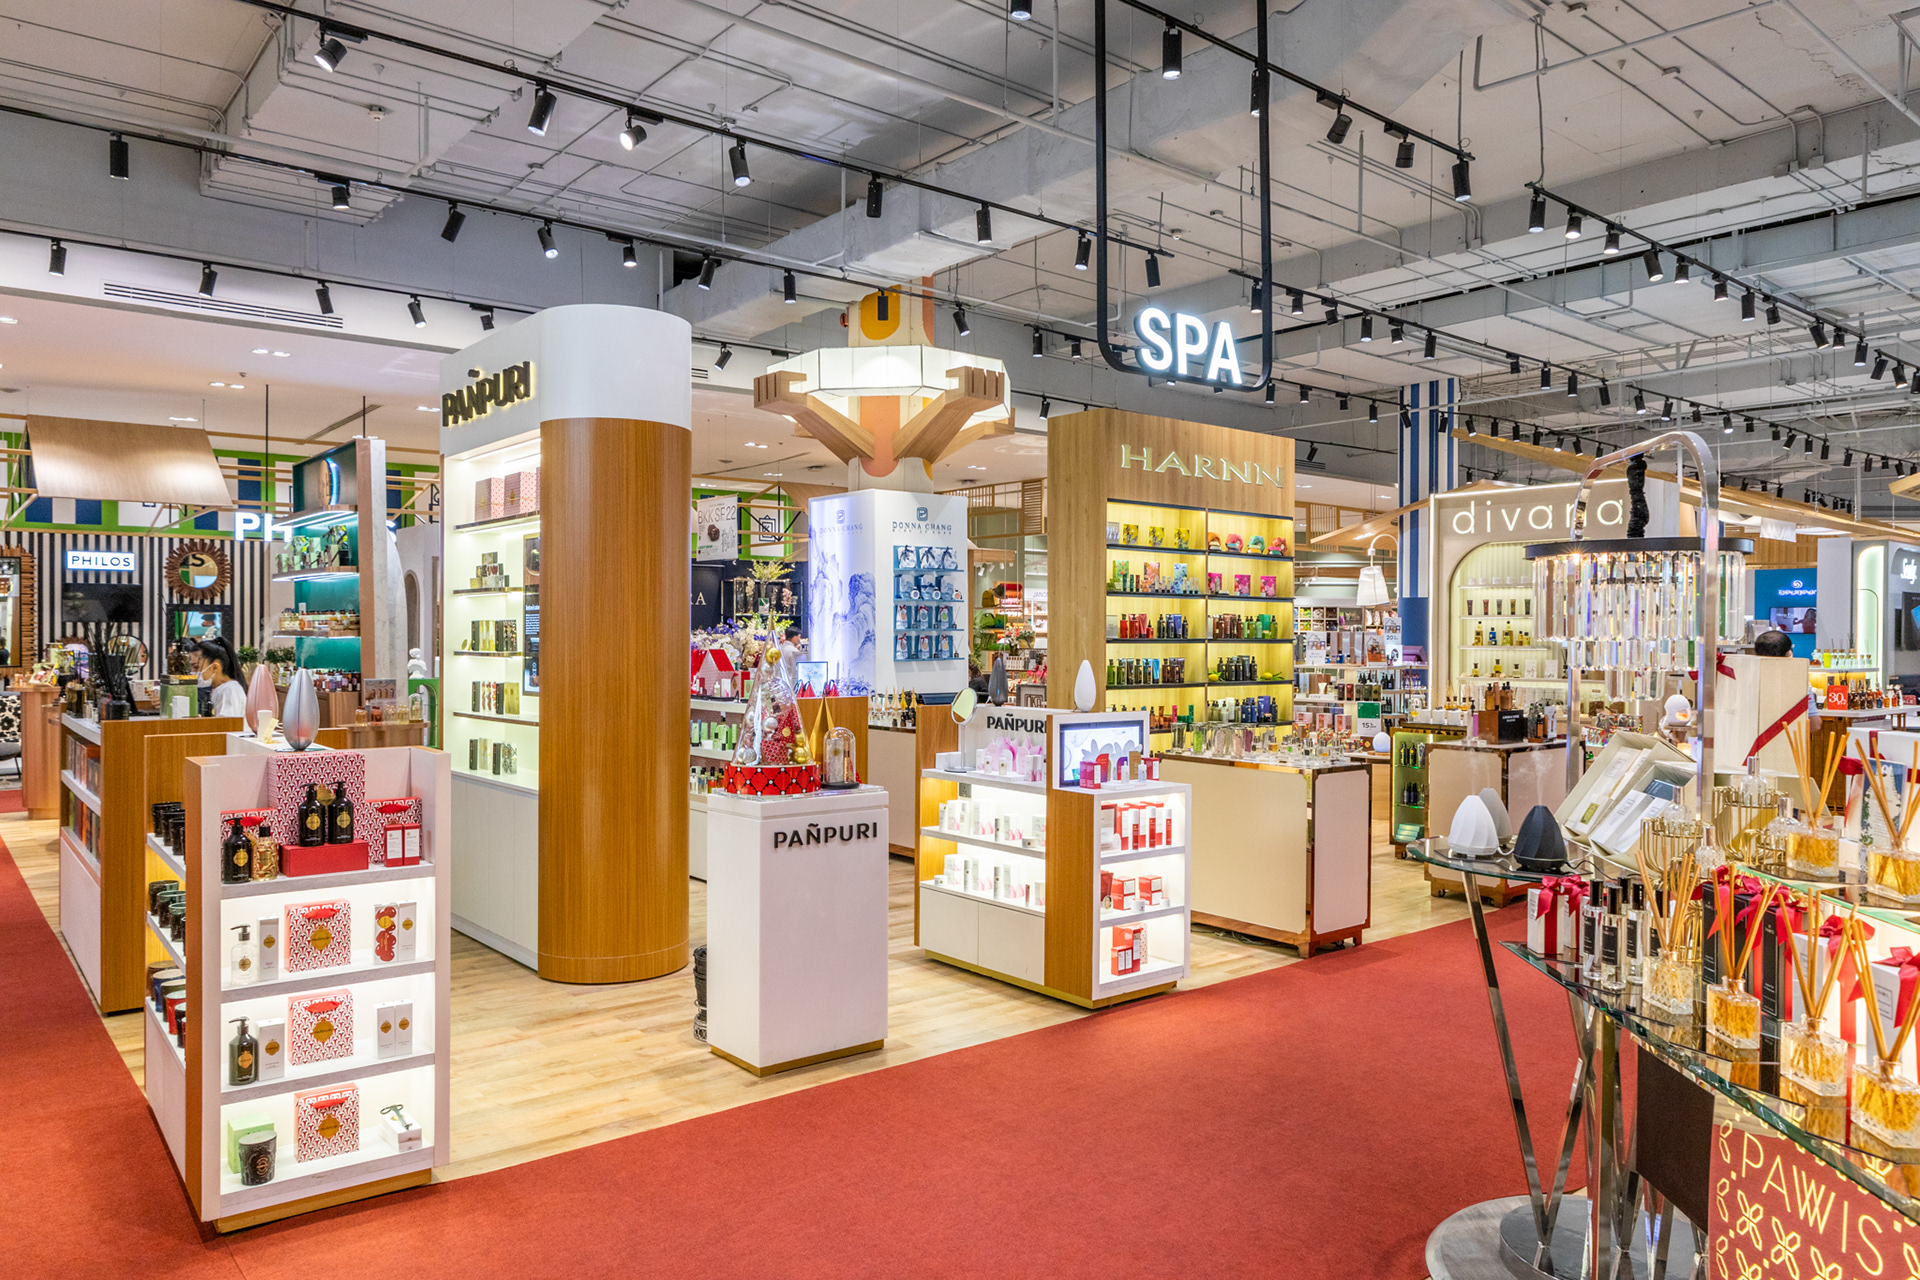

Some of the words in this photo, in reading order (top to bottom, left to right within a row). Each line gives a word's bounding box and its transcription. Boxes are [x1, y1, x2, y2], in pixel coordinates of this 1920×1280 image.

[1134, 307, 1243, 385] SPA
[442, 361, 531, 427] PAÑPURI
[1121, 444, 1284, 488] HARNN
[892, 521, 922, 530] DONNA
[925, 523, 952, 531] CHANG
[71, 555, 131, 567] PHILOS
[774, 822, 877, 848] PAÑPURI
